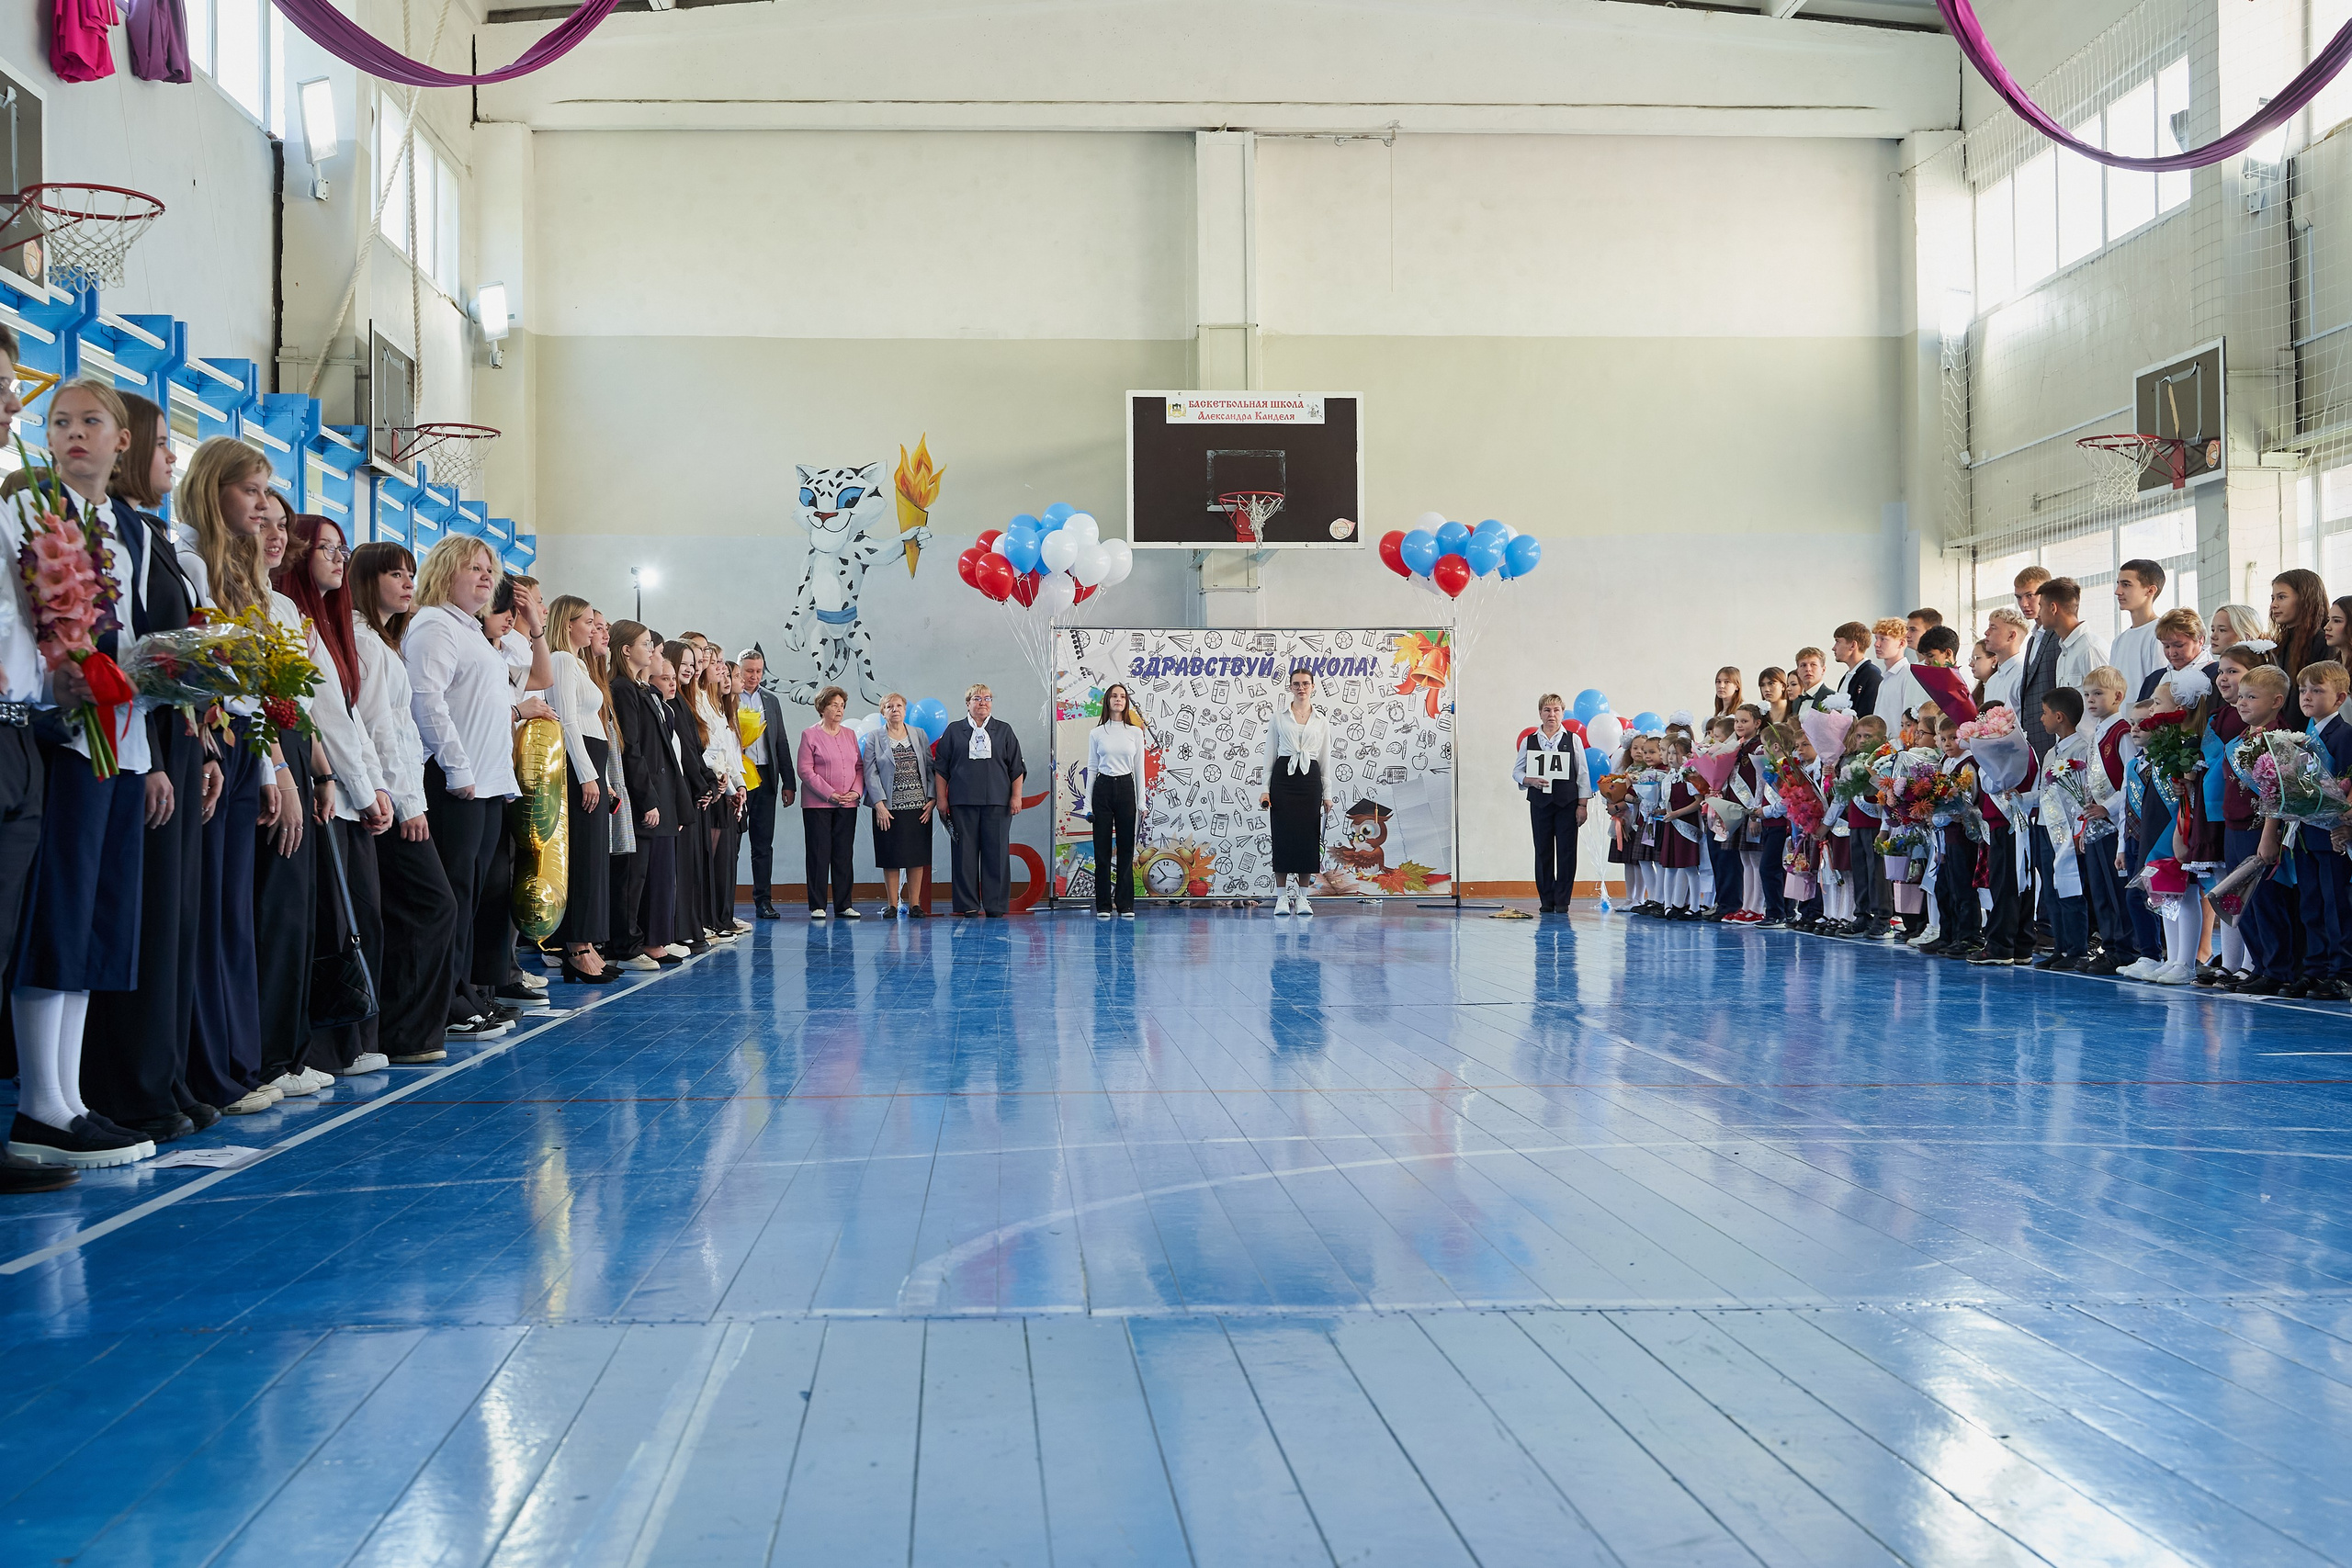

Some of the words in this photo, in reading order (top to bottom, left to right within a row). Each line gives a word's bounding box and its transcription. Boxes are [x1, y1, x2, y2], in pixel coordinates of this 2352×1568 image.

[1188, 400, 1268, 409] БАСКЕТБОЛЬНАЯ
[1270, 400, 1305, 409] ШКОЛА
[1198, 411, 1251, 422] Александра
[1255, 411, 1295, 422] Канделя
[1288, 657, 1377, 678] ШКОЛА!
